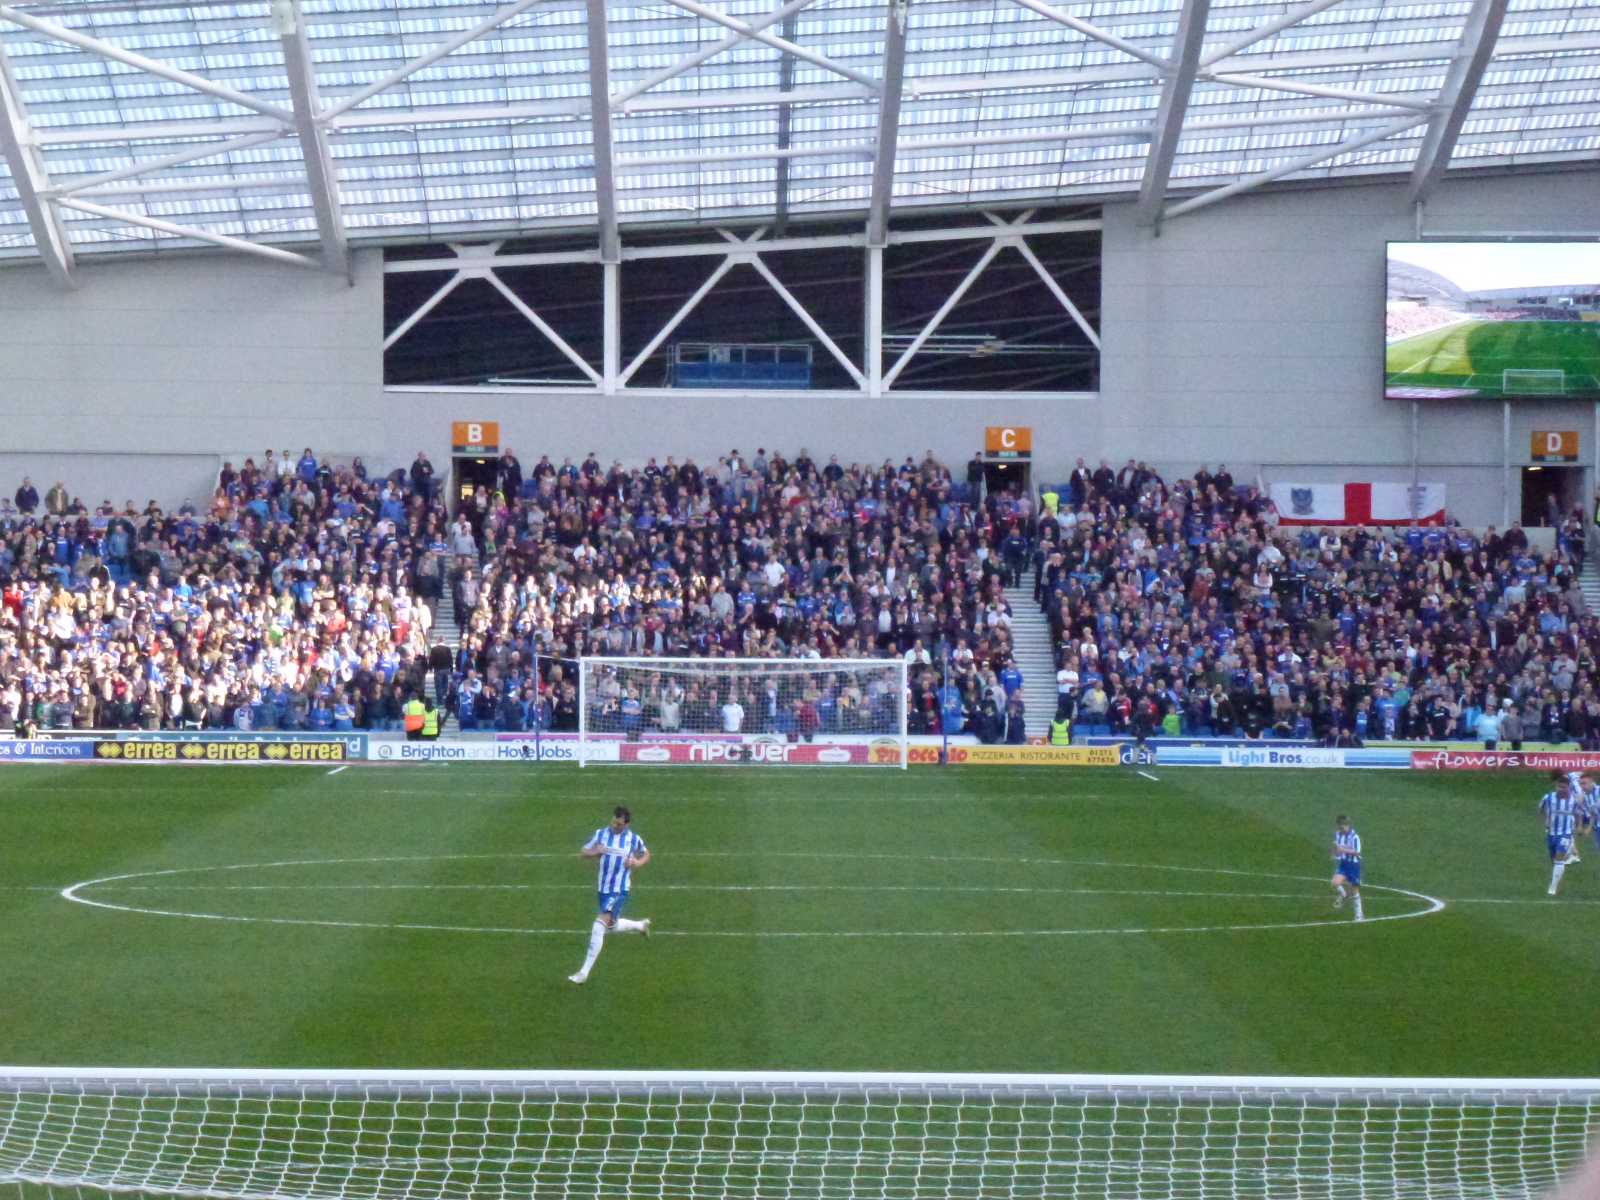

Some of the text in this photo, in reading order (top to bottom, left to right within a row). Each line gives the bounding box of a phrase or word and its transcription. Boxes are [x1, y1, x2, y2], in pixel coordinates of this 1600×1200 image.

[468, 424, 482, 442] B
[1002, 429, 1016, 448] C
[1547, 433, 1561, 451] D
[31, 743, 80, 755] Interiors
[124, 742, 177, 759] errea
[207, 743, 260, 760] errea
[290, 743, 342, 760] errea
[401, 744, 465, 760] Brighton
[972, 752, 1014, 761] PIZZERIA
[1020, 752, 1081, 761] RISTORANTE
[1228, 751, 1266, 765] Light
[1524, 755, 1600, 767] Unlimite
